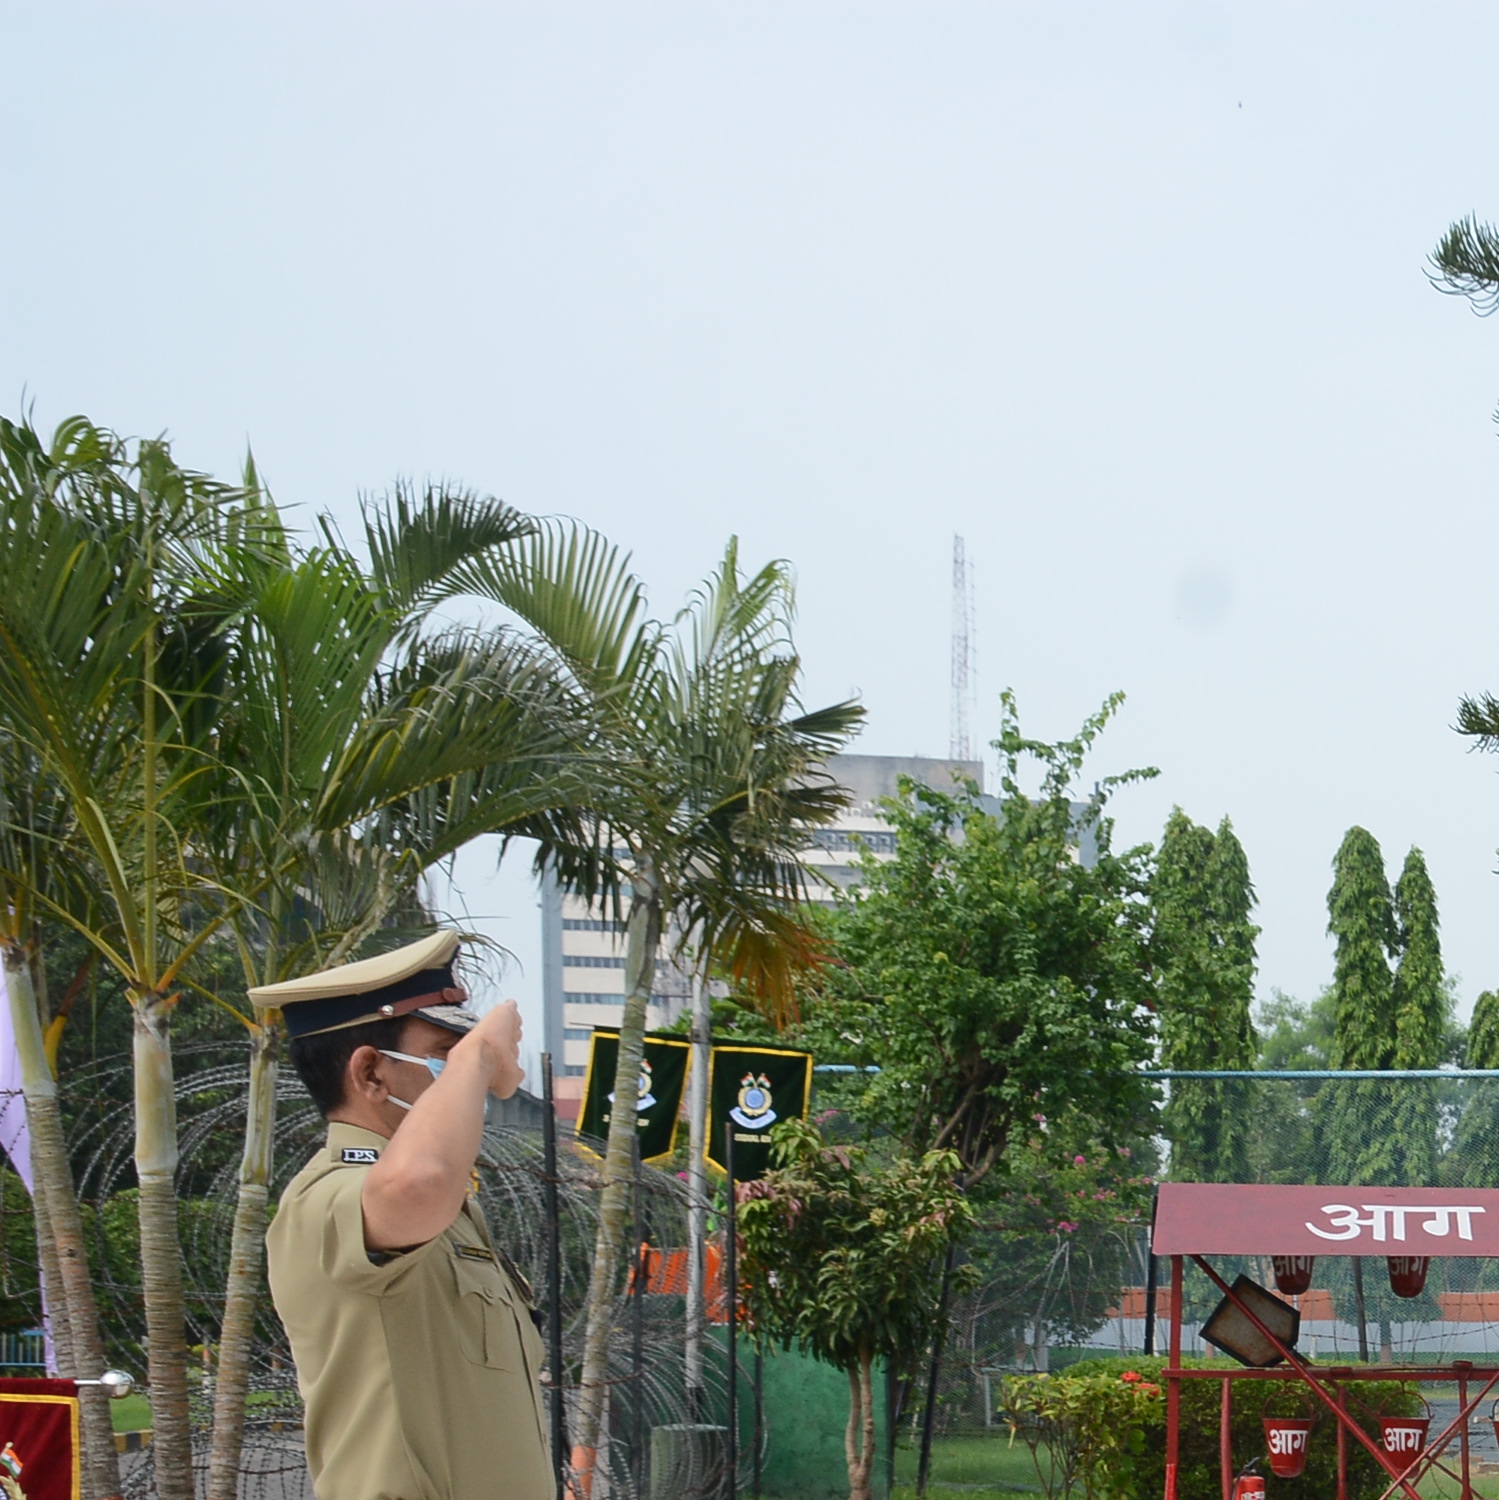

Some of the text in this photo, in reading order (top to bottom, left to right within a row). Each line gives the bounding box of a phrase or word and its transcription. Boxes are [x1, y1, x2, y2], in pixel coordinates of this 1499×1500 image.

[1305, 1204, 1486, 1241] आग
[1269, 1429, 1308, 1454] आग
[1383, 1427, 1423, 1452] आग
